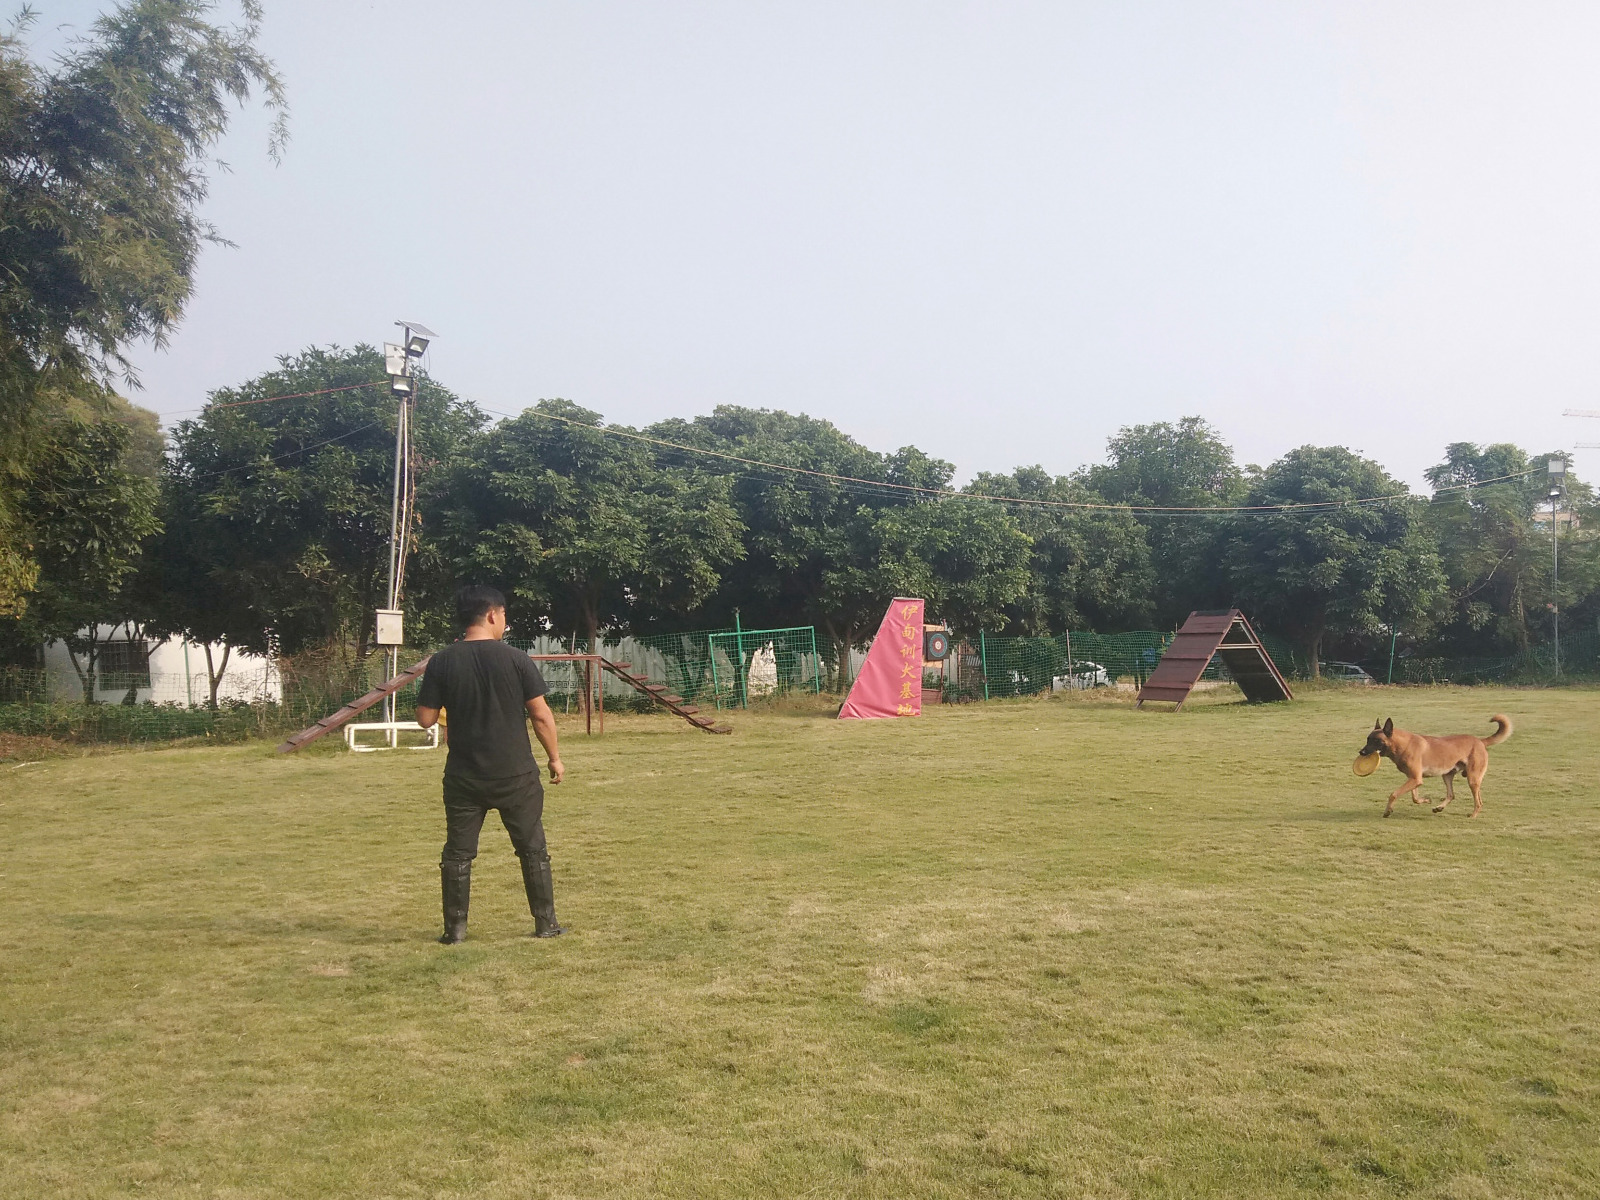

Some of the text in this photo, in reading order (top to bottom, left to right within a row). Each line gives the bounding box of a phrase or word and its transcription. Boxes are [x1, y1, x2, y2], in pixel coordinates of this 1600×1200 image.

[897, 605, 918, 716] 伊甸训犬基地
